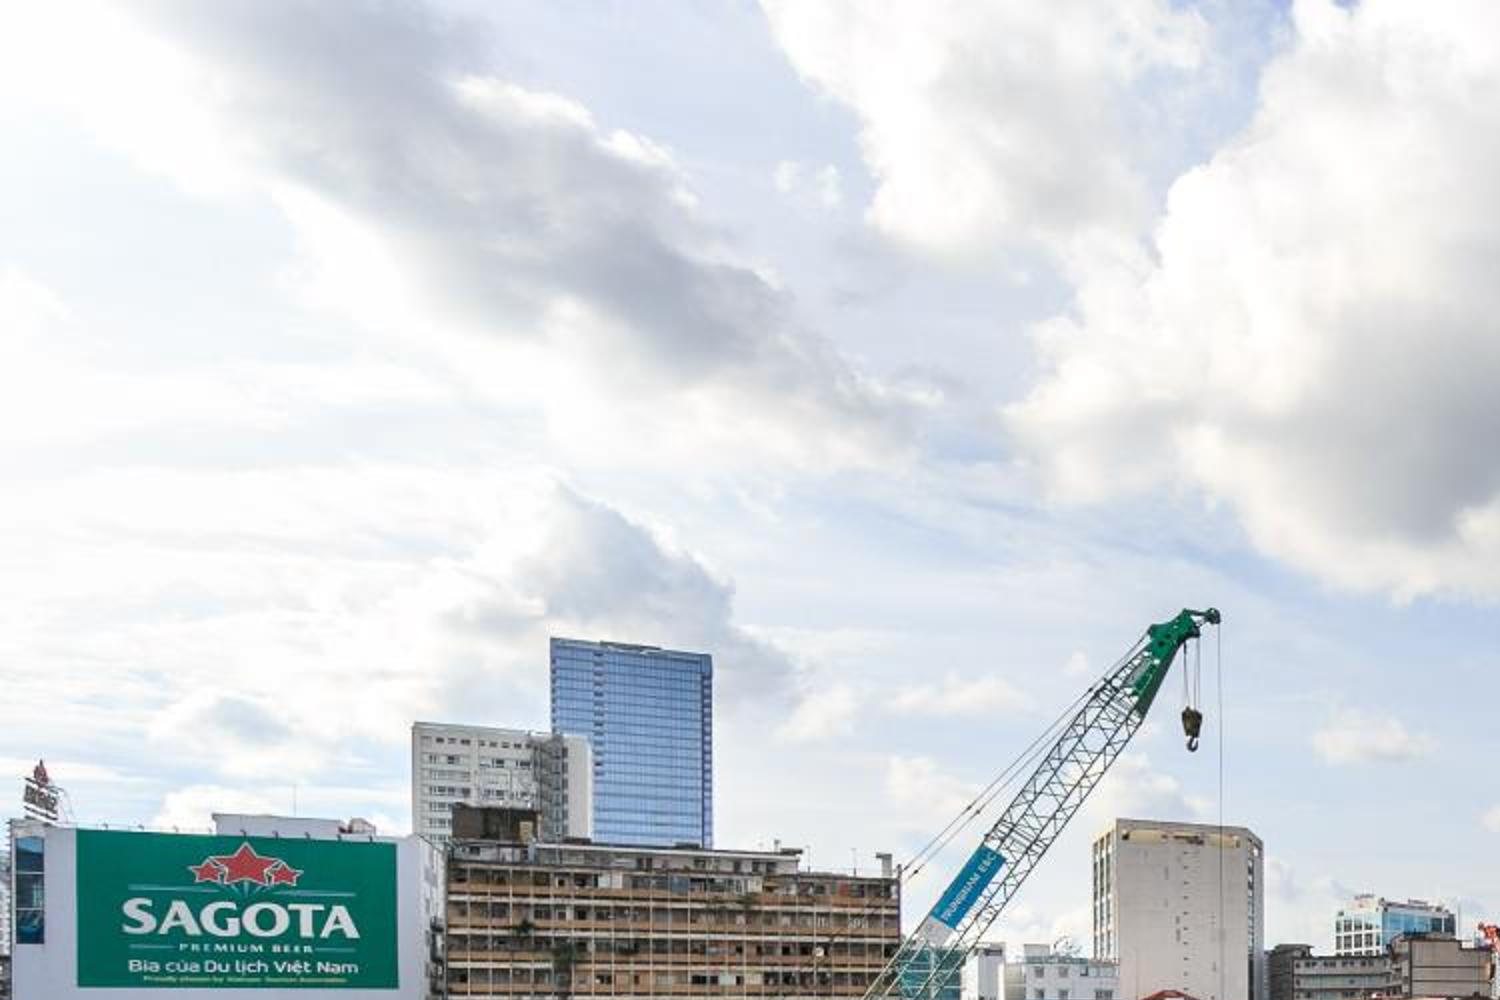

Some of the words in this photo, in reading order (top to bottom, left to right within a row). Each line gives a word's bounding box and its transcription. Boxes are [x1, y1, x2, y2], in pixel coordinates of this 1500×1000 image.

[121, 897, 361, 940] SAGOTA
[179, 943, 264, 953] PREMIUM
[272, 944, 313, 954] BEER
[128, 959, 161, 972] Bia
[165, 960, 200, 973] của
[204, 960, 230, 973] Du
[235, 959, 269, 976] lịch
[273, 960, 311, 976] Việt
[317, 961, 359, 974] Nam
